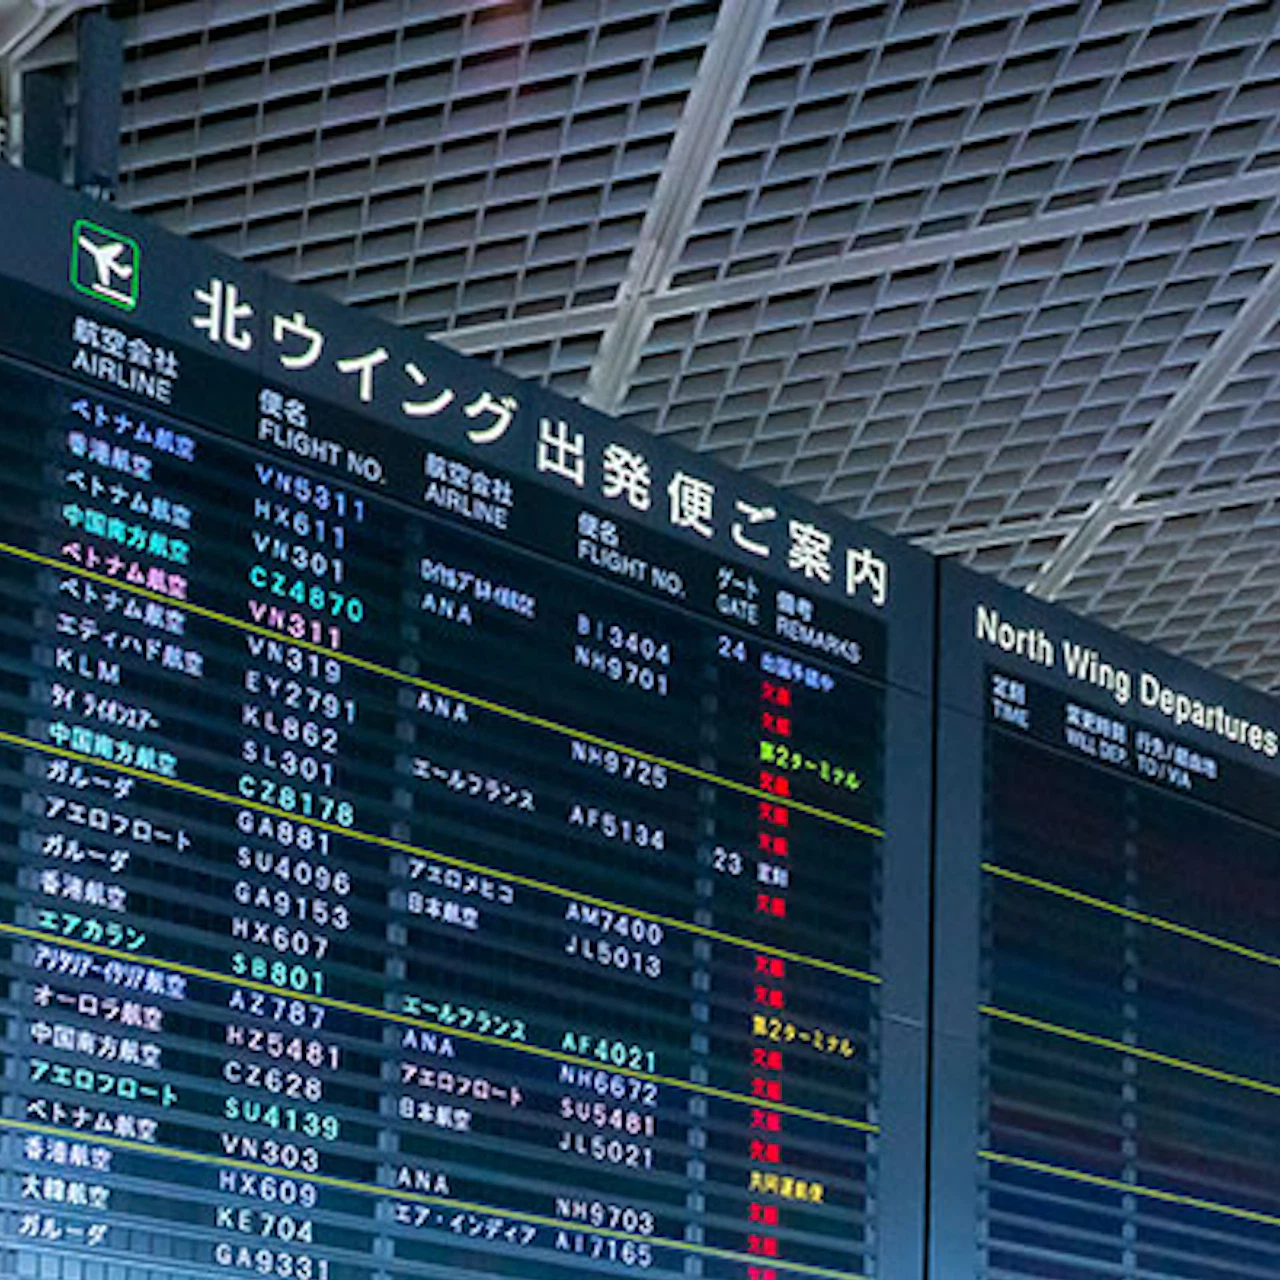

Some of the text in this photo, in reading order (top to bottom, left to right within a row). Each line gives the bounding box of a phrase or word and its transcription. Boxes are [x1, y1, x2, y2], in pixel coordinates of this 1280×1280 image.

[72, 312, 179, 380] 航空会社
[71, 344, 173, 407] AIRLINE
[258, 414, 386, 487] FLIGHT NO.
[251, 530, 343, 584] VN301
[248, 599, 341, 652] VN311
[419, 589, 472, 629] ANA
[54, 645, 120, 689] KLM
[246, 633, 341, 686] VN319
[718, 634, 746, 664] 24
[244, 668, 355, 725] EY2791
[976, 605, 1280, 758] North Wing Departures
[242, 703, 338, 754] KL862
[415, 688, 468, 726] ANA
[241, 738, 334, 787] SL301
[237, 808, 330, 856] GA881
[235, 843, 350, 896] SU4096
[713, 846, 742, 875] 23
[234, 879, 348, 931] GA9153
[232, 914, 328, 961] HX607
[401, 1026, 454, 1060] ANA
[224, 1059, 323, 1102] CZ628
[223, 1095, 338, 1141] SU4139
[221, 1131, 318, 1173] VN303
[219, 1168, 317, 1209] HX609
[396, 1165, 449, 1198] ANA
